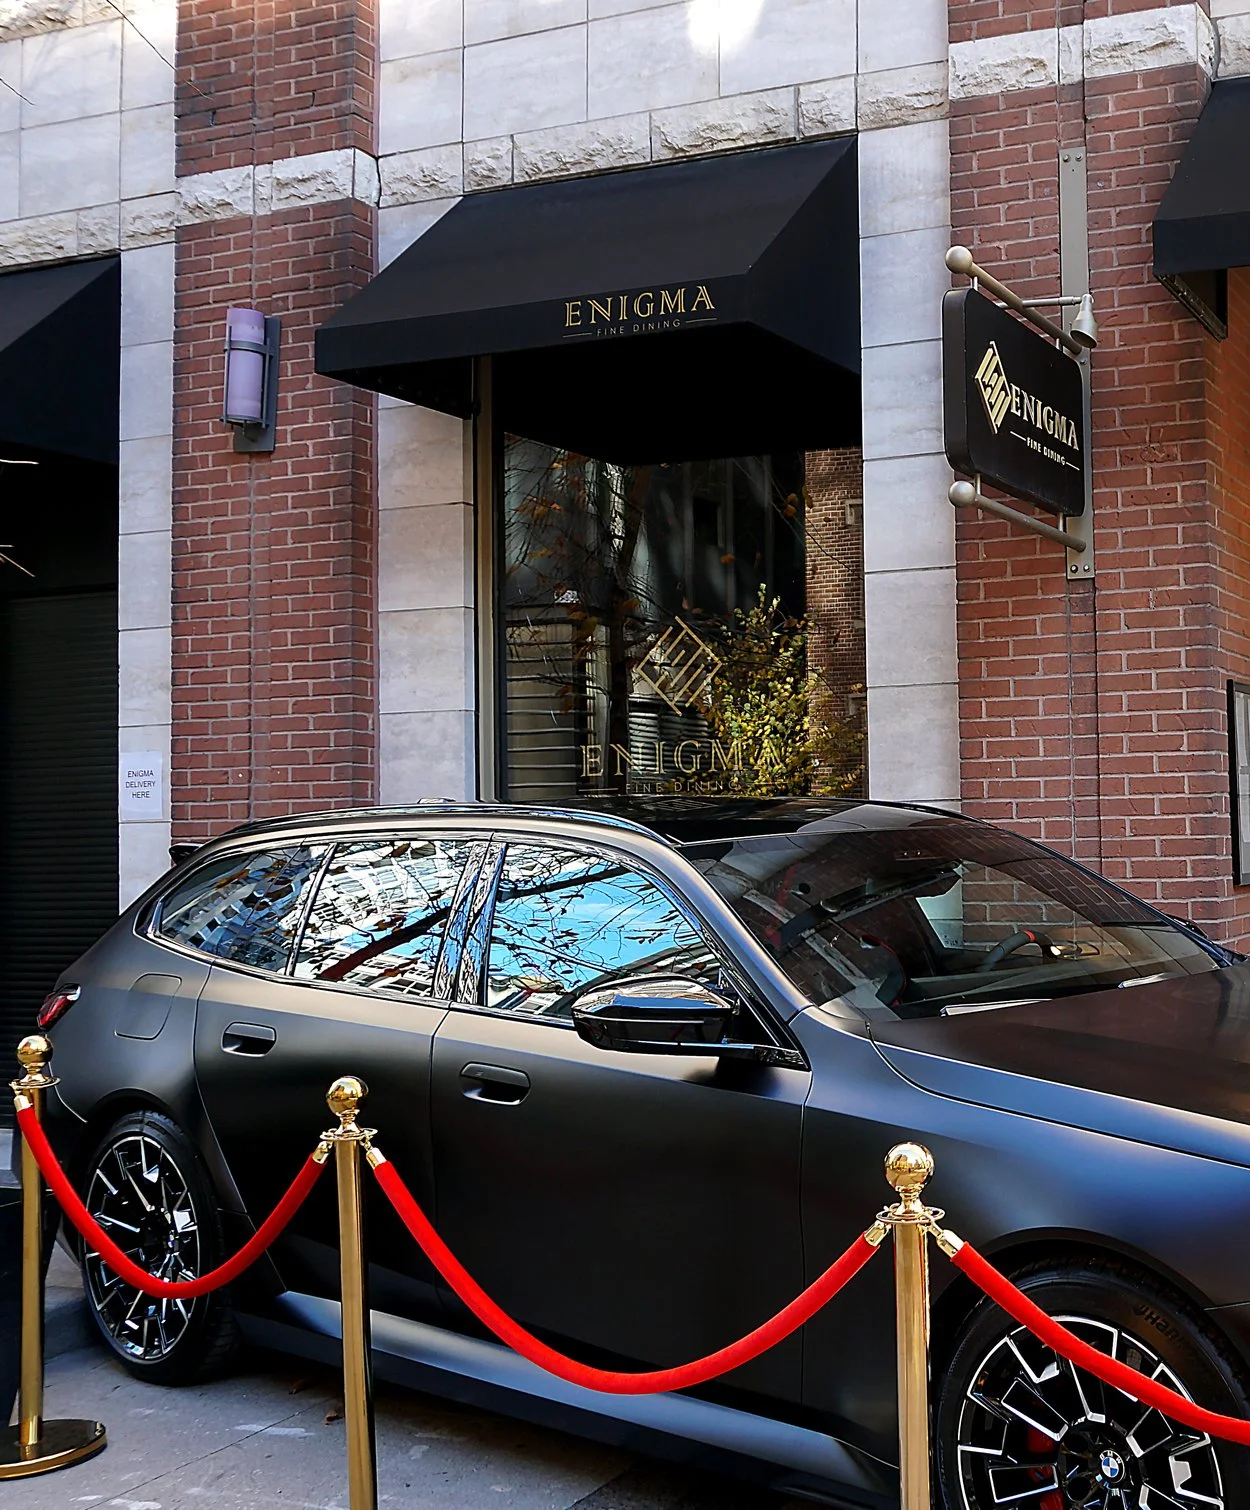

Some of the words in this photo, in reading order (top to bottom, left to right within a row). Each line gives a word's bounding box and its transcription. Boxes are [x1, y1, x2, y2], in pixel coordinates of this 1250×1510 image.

[564, 285, 715, 327] ENIGMA
[597, 325, 625, 336] FINE
[633, 318, 681, 332] DINING
[1010, 382, 1079, 451] ENIGMA
[1027, 437, 1042, 453] FINE
[1043, 446, 1066, 466] DINING
[580, 739, 786, 777] ENIGMA
[127, 769, 154, 778] ENIGMA
[125, 780, 156, 789] DELIVERY
[626, 783, 664, 793] FINE
[131, 790, 151, 799] HERE
